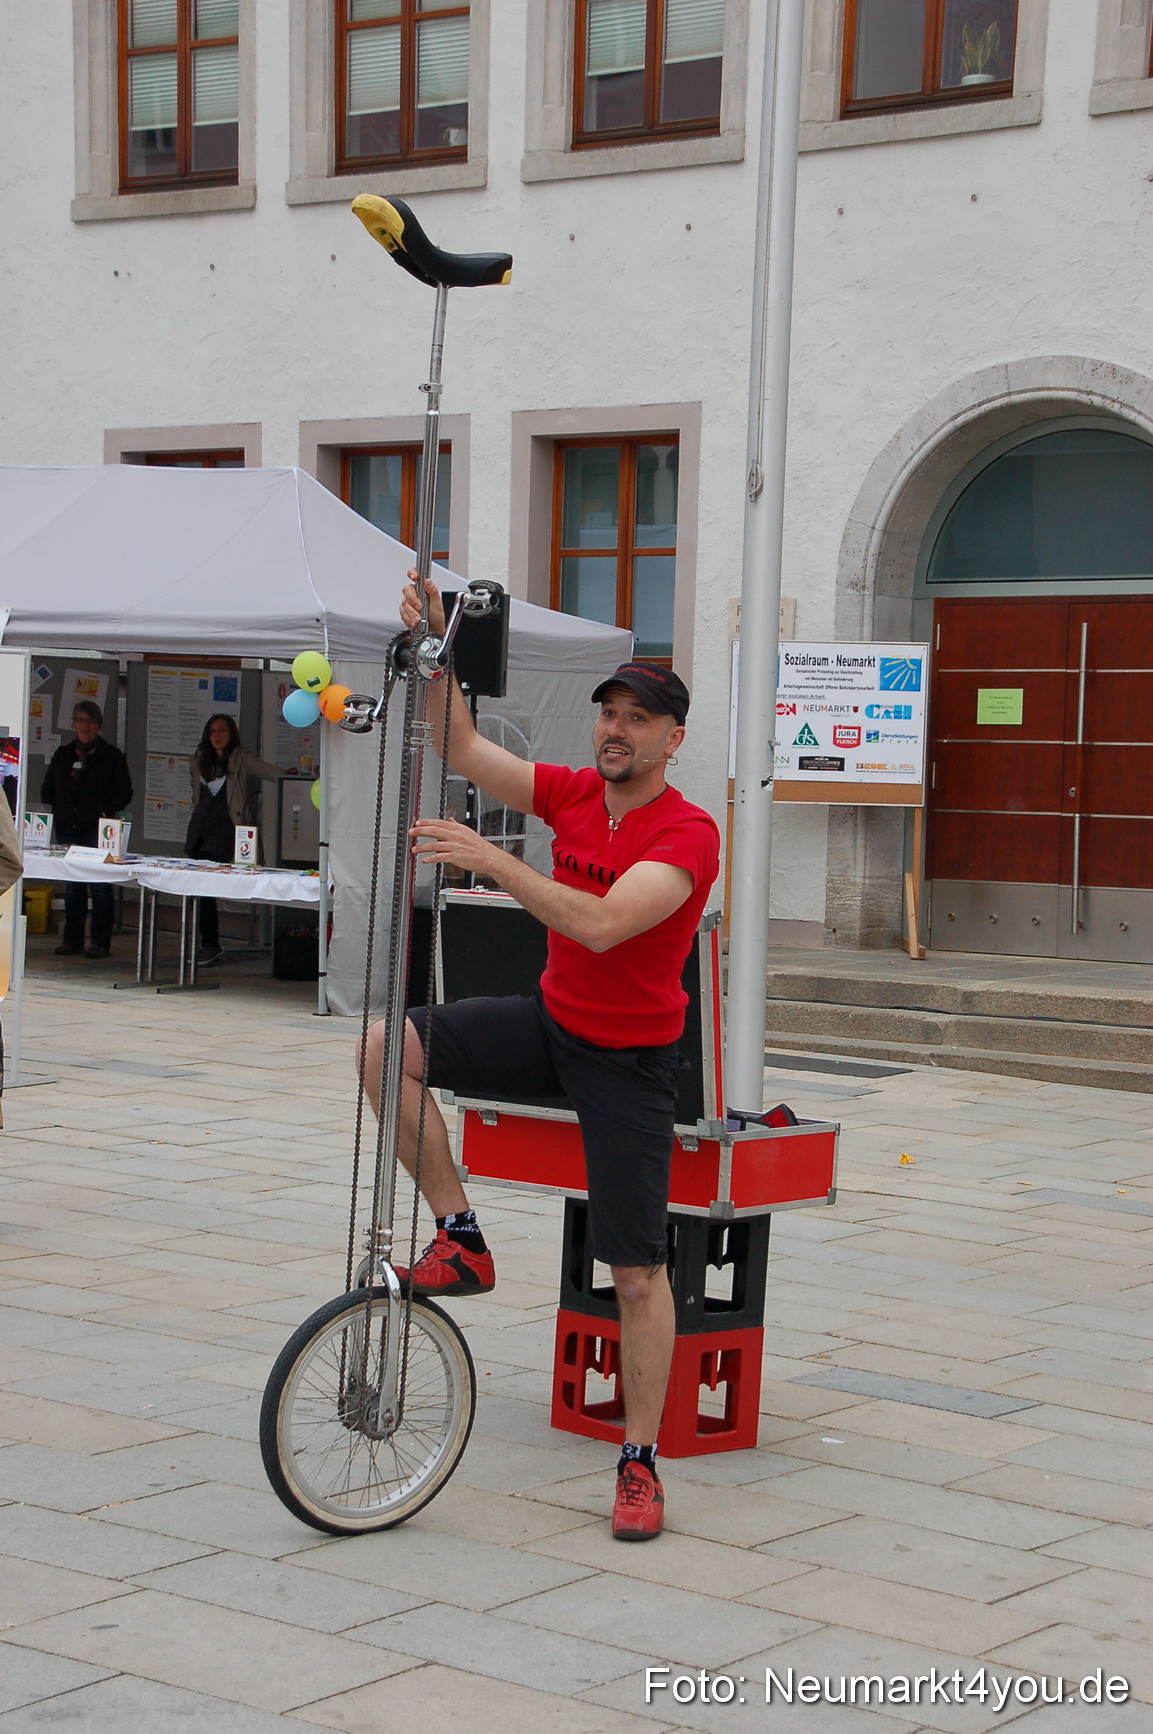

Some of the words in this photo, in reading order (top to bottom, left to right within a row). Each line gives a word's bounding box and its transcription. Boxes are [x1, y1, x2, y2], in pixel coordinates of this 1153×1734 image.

[784, 653, 829, 666] Sozialraum
[836, 654, 876, 668] Neumarkt
[803, 704, 850, 713] NEUMARKT
